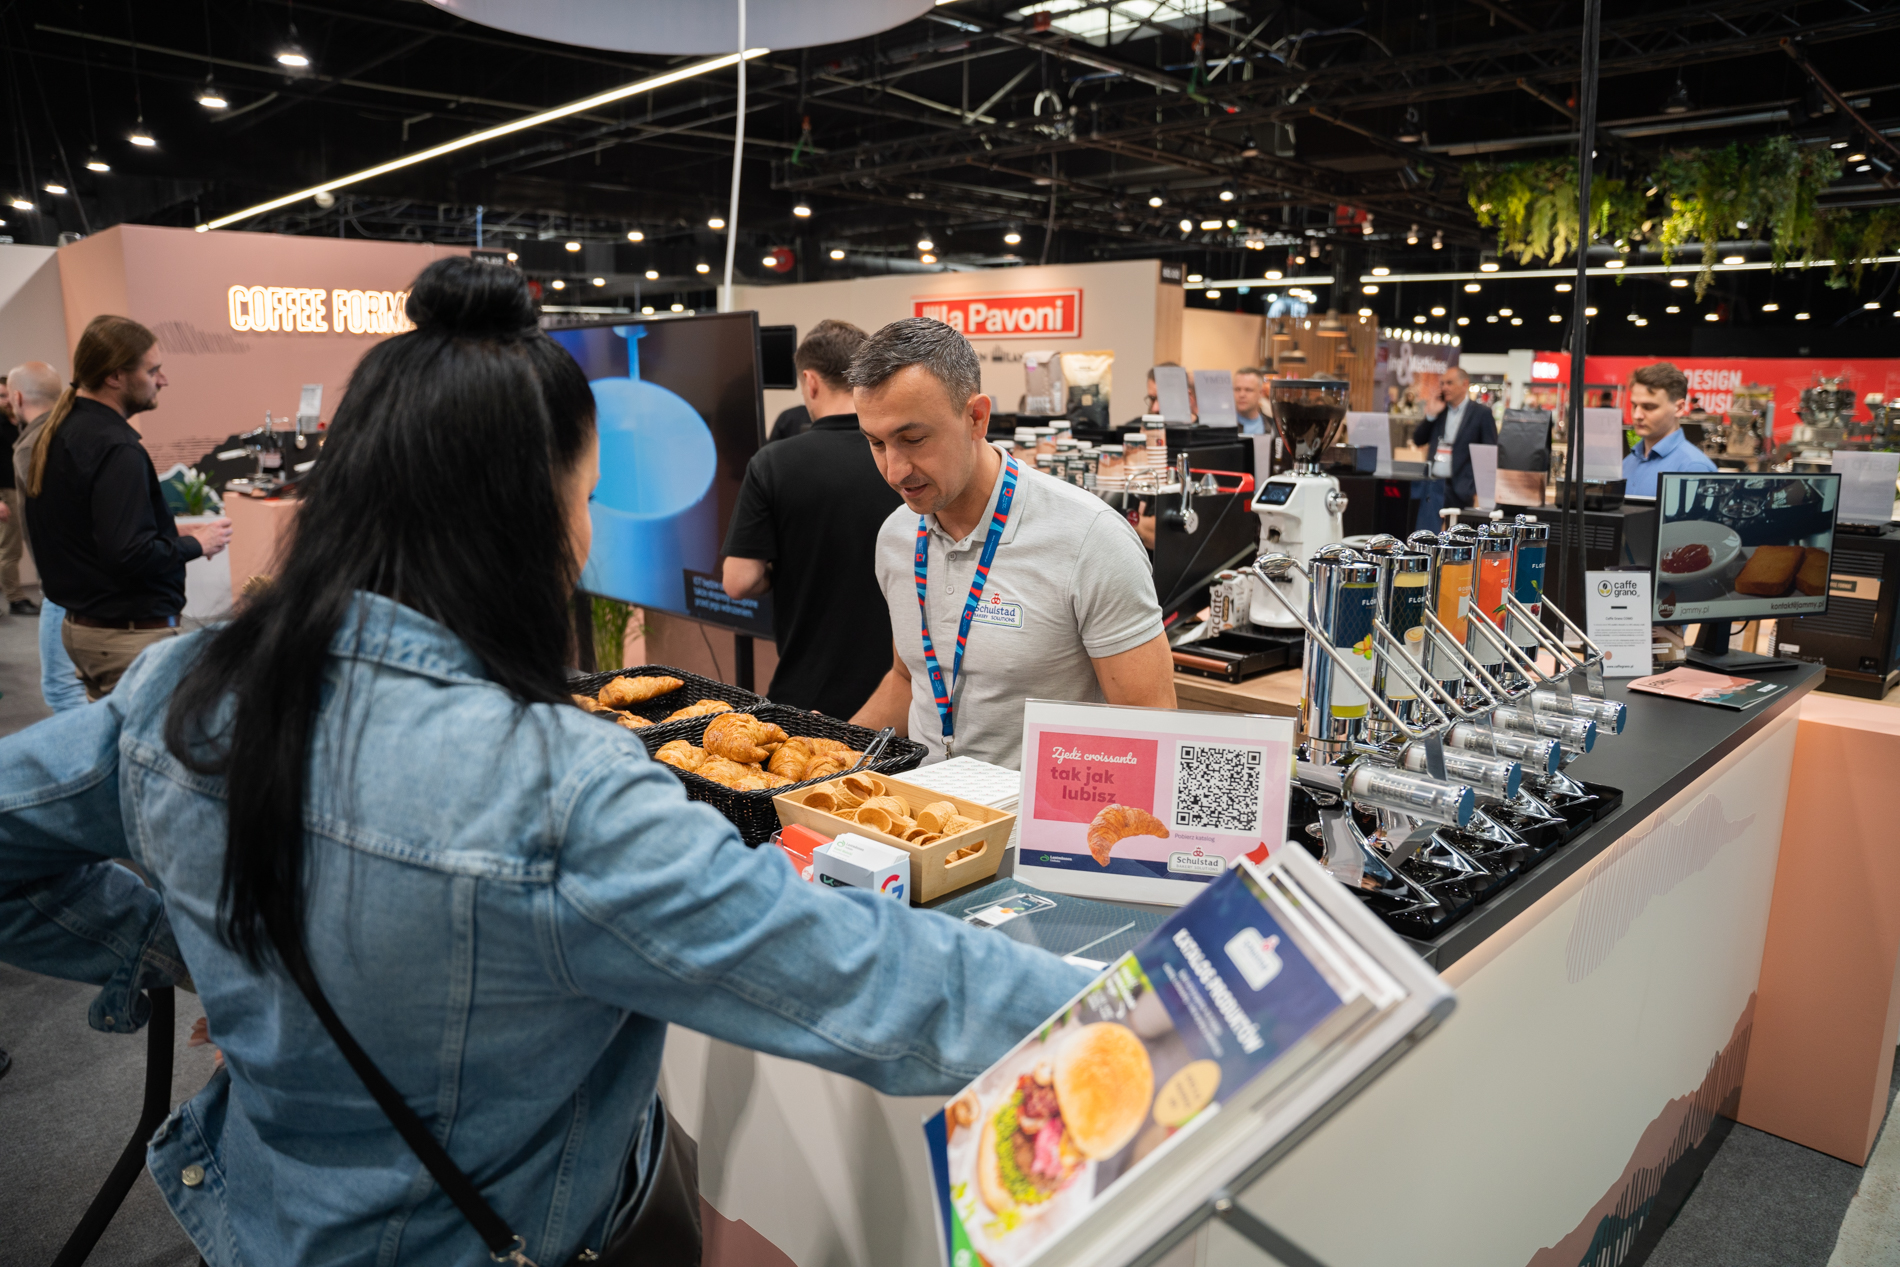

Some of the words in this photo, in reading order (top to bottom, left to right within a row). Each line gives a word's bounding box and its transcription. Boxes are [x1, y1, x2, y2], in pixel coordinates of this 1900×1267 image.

[228, 285, 329, 332] COFFEE
[332, 289, 414, 334] FORM
[968, 299, 1064, 332] Pavoni
[1683, 369, 1742, 391] DESIGN
[1613, 580, 1637, 590] caffe
[1613, 589, 1638, 598] grano
[975, 604, 1016, 617] Schulstad
[1210, 589, 1223, 637] aciate
[1680, 606, 1710, 616] jammy.pl
[1770, 600, 1825, 611] kontakt@jammy.pl
[1052, 746, 1082, 764] Zjedź
[1084, 752, 1137, 765] croissanta
[1050, 766, 1081, 781] tak
[1084, 766, 1114, 786] jak
[1062, 785, 1116, 803] lubisz
[1174, 833, 1195, 842] Pobierz
[1195, 834, 1216, 843] katalog
[1176, 855, 1219, 867] Schulstad
[1172, 927, 1217, 986] KATALOG
[1205, 975, 1265, 1054] PRODUKTÓW
